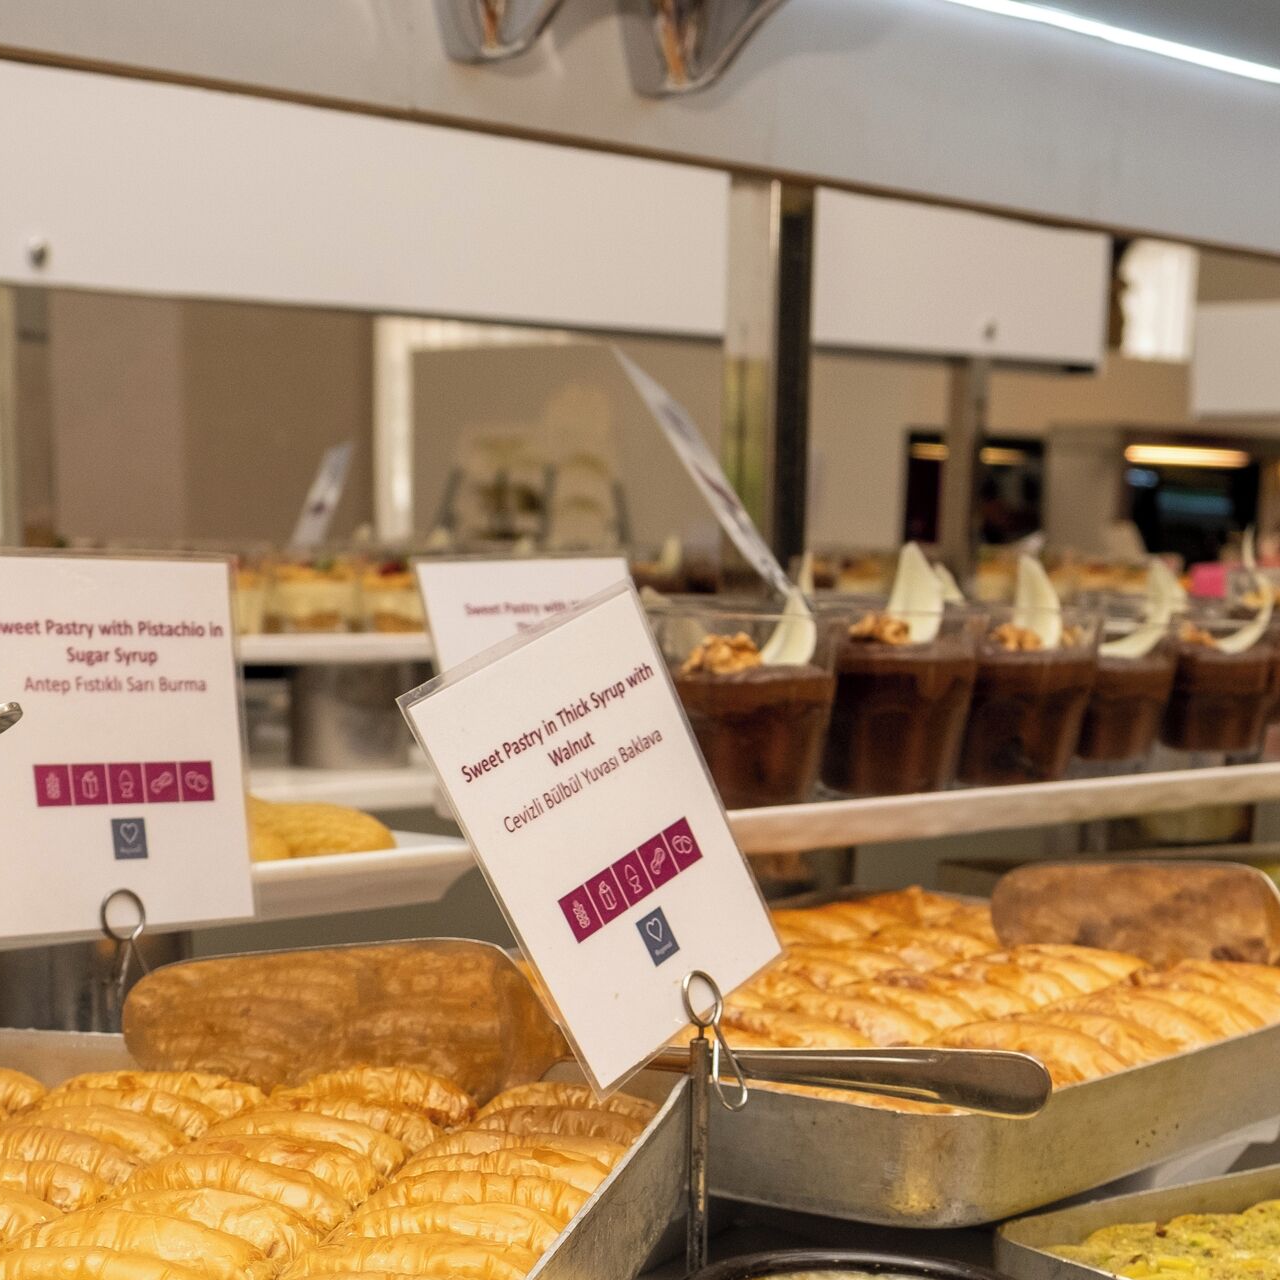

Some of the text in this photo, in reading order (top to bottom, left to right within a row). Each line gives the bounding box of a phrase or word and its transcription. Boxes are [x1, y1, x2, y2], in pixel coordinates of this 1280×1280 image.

[46, 619, 94, 638] Pastry
[98, 619, 133, 636] with
[138, 621, 205, 637] Pistachio
[209, 622, 224, 637] in
[66, 647, 158, 666] Sugar Syrup
[24, 676, 207, 694] Antep Fıstıklı Sarı Burma
[461, 662, 655, 783] Sweet Pastry in Thick Syrup with
[547, 731, 596, 767] Walnut
[503, 729, 663, 833] Cevizli Bülbül Yuvası Baklava
